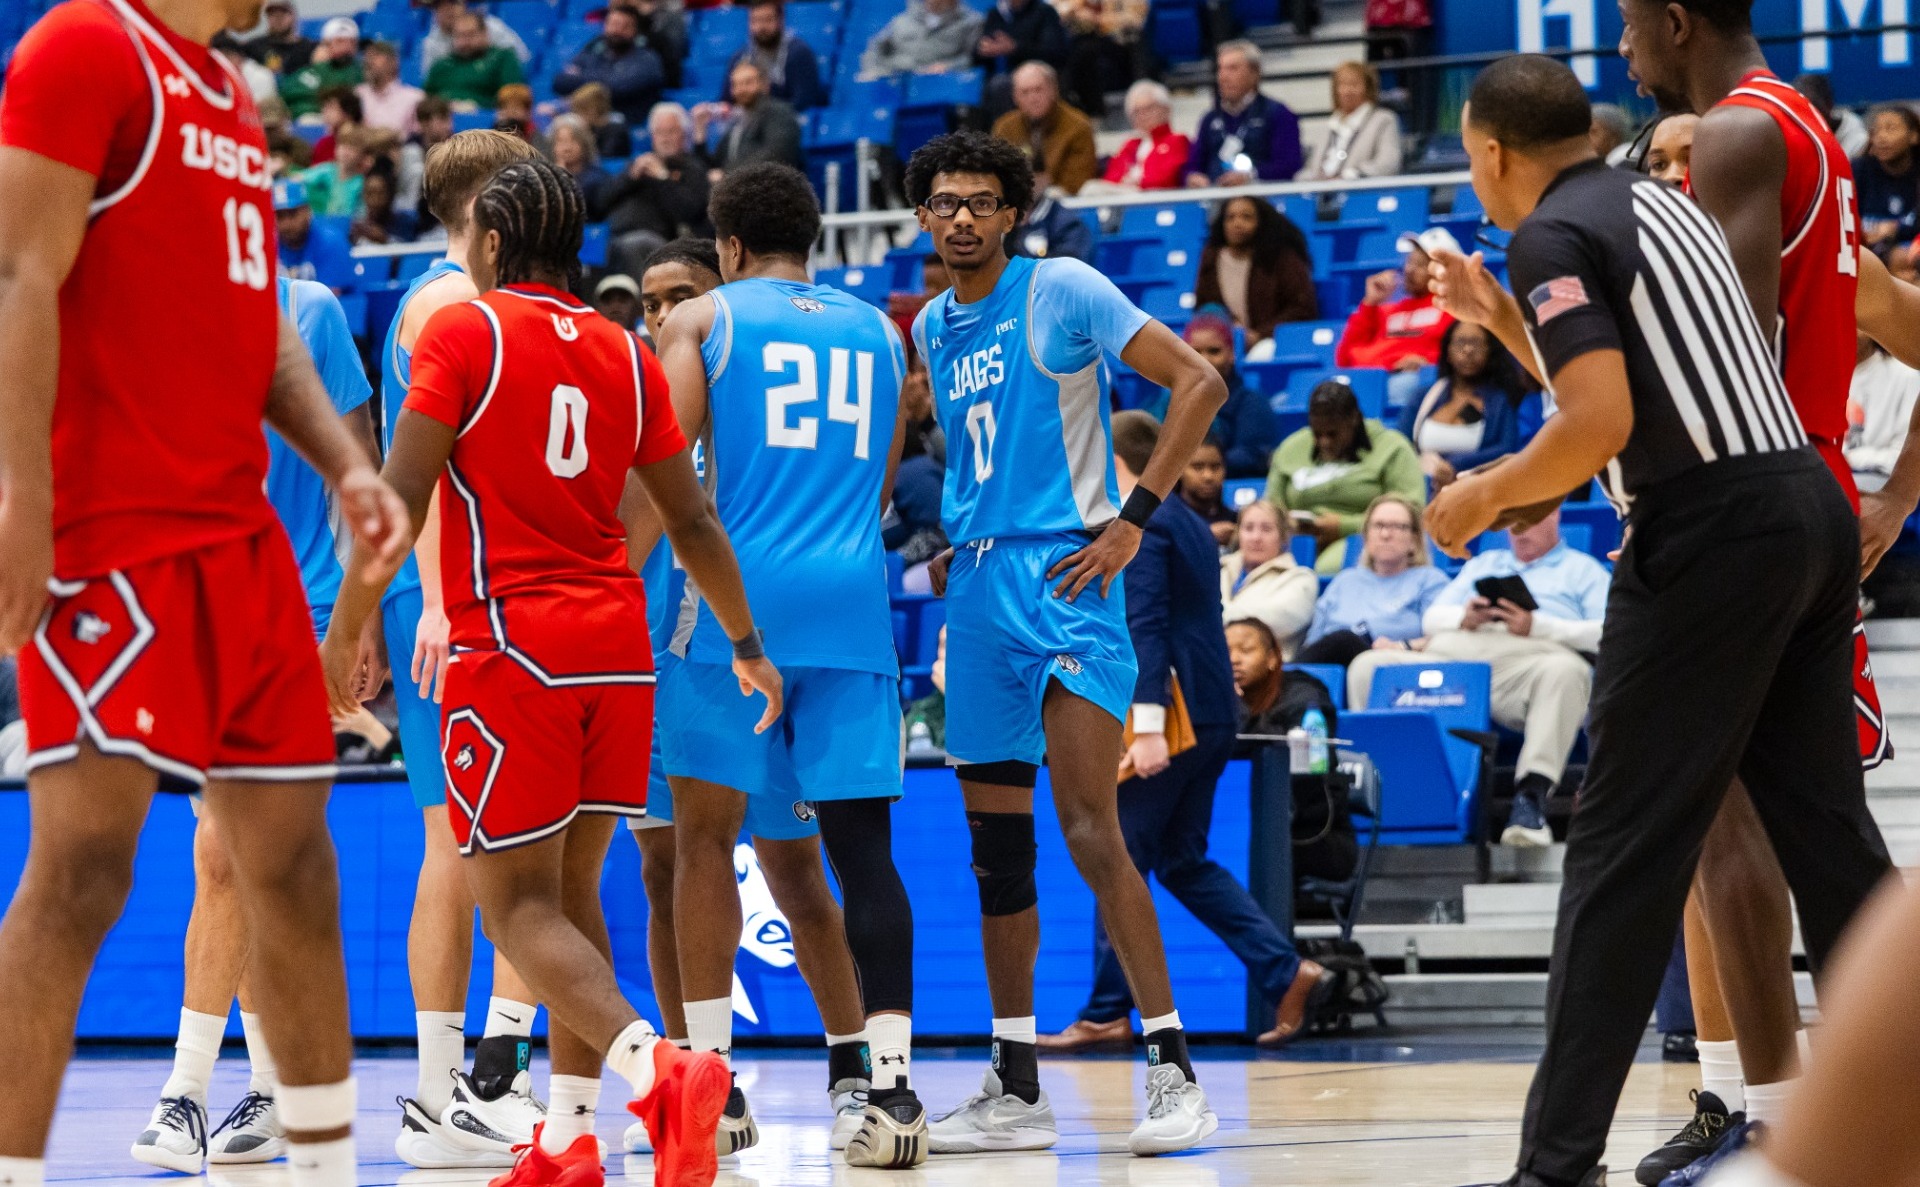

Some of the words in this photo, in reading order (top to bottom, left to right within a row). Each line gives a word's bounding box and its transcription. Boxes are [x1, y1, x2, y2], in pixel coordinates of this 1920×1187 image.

[223, 196, 269, 291] 13
[762, 341, 874, 460] 24
[949, 343, 1004, 401] JAGS
[545, 383, 589, 479] 0
[966, 400, 996, 484] 0
